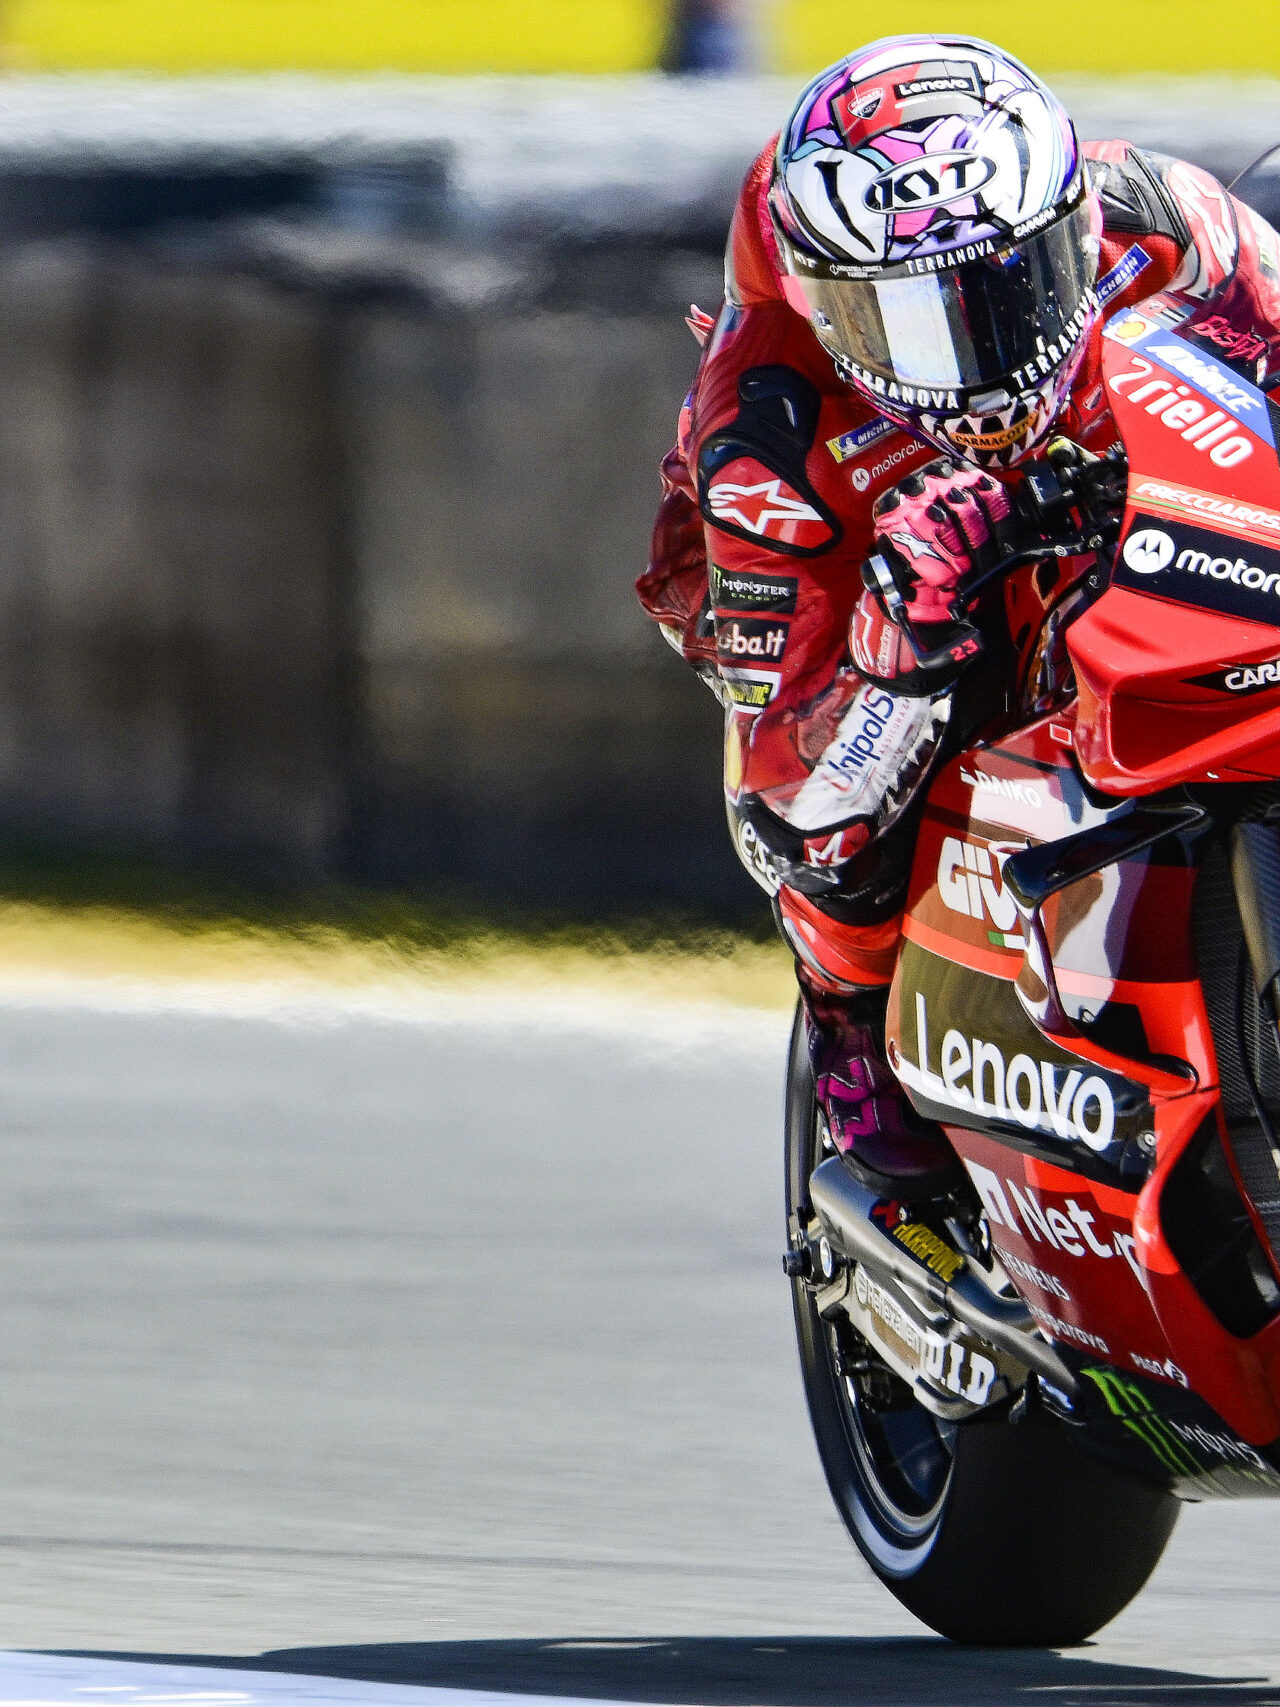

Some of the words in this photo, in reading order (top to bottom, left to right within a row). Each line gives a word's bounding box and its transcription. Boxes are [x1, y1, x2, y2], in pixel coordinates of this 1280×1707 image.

[898, 79, 970, 96] Lenovo
[873, 157, 979, 211] KYT
[905, 239, 995, 274] TERRANOVA
[1097, 256, 1139, 301] ICHELIN
[1012, 287, 1099, 389] TERRANOVA
[842, 354, 959, 409] TERRANOVA
[857, 420, 895, 445] MICHE
[722, 578, 790, 597] MONSTER
[820, 685, 897, 792] UnipolS
[938, 836, 1020, 931] GIV
[916, 991, 1116, 1151] Lenovo
